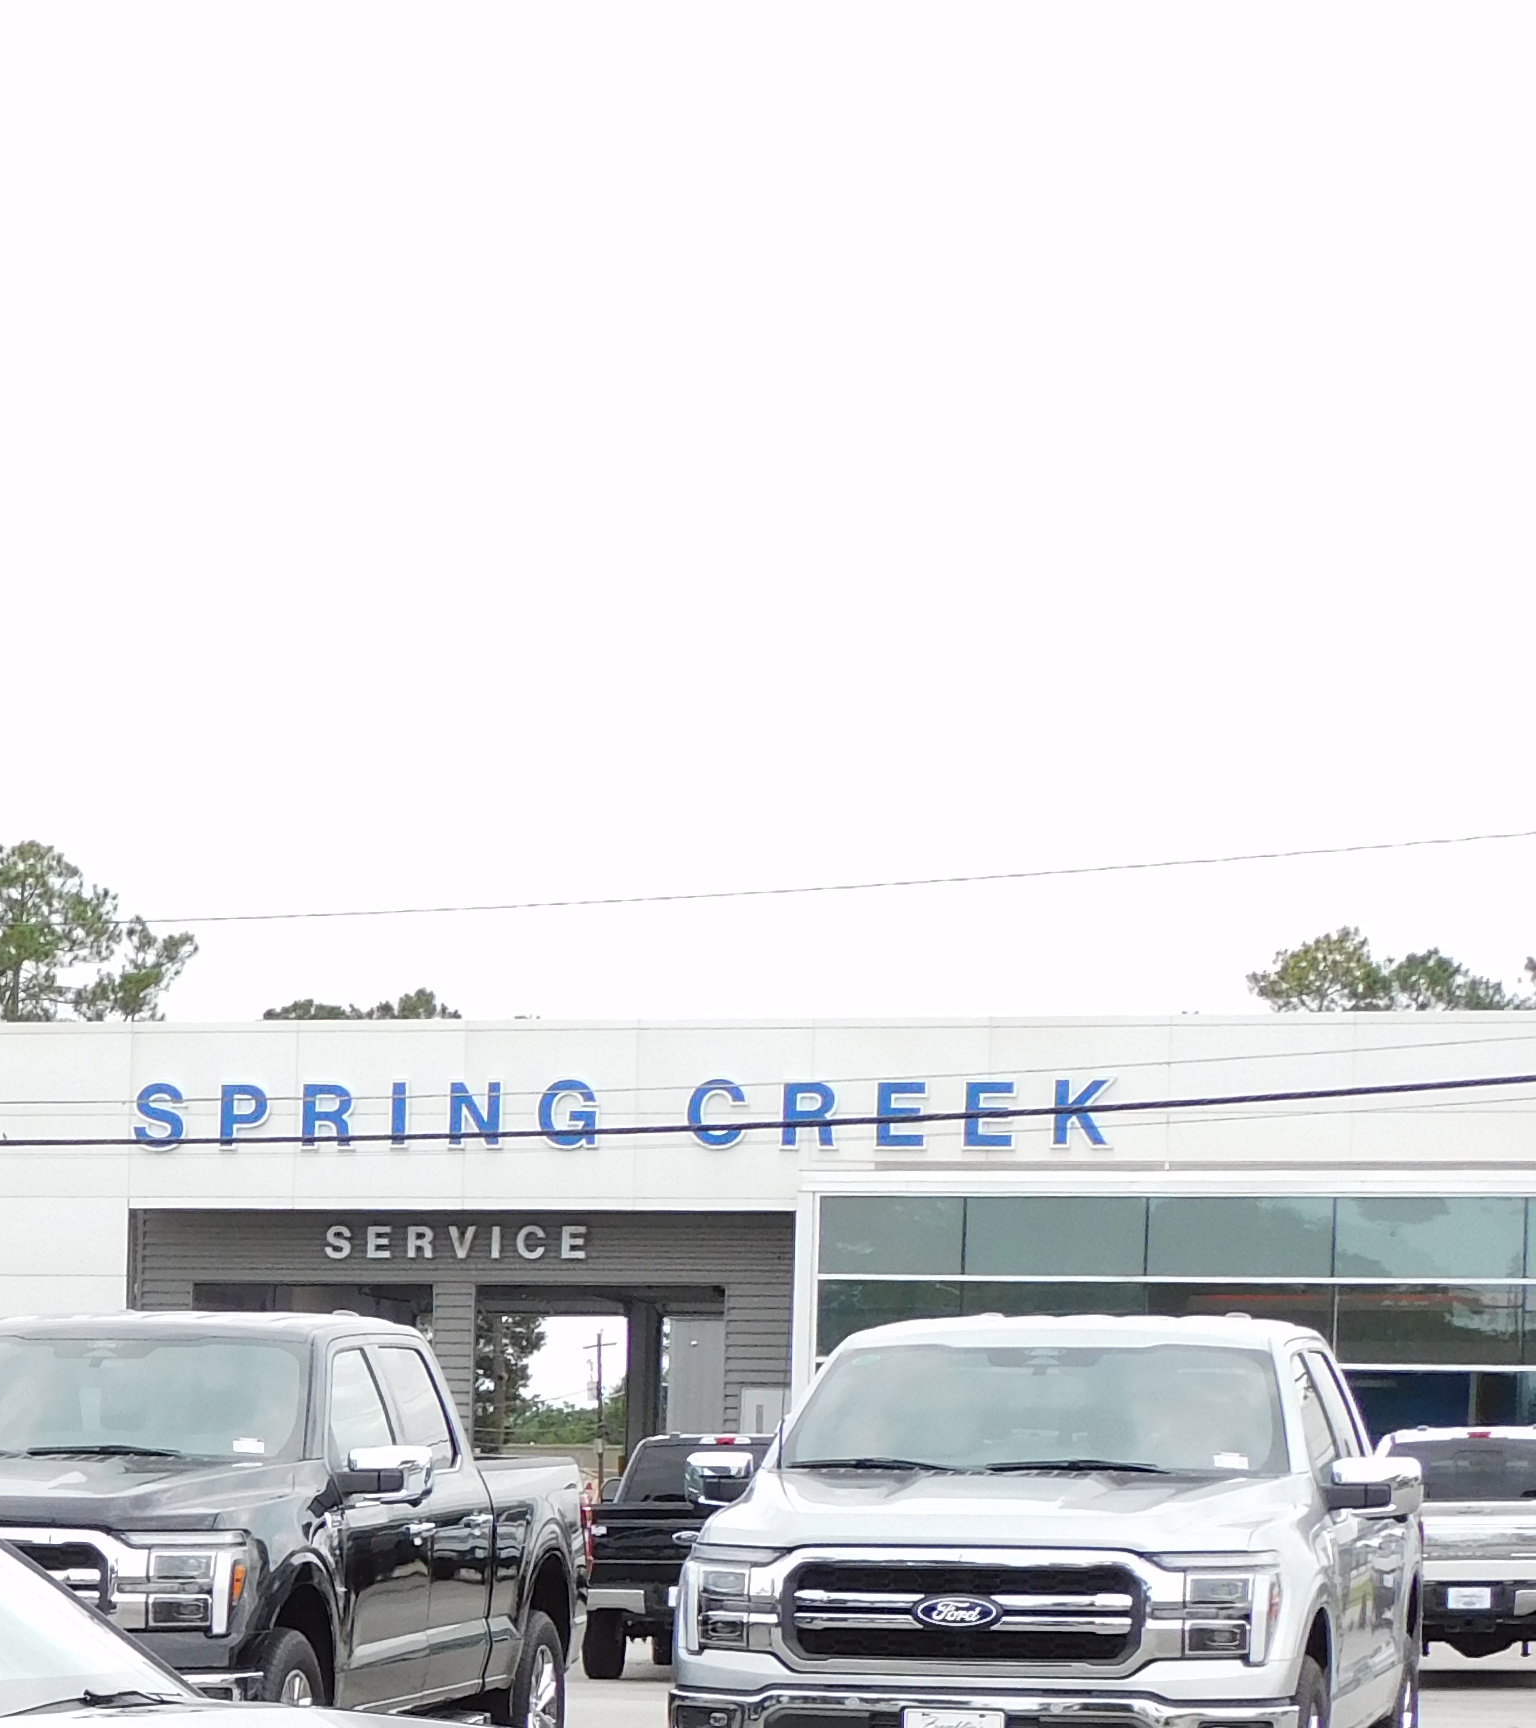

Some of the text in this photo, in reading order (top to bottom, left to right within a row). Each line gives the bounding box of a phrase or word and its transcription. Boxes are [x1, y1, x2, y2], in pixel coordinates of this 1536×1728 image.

[132, 1077, 1117, 1152] SPRING CREEK
[324, 1225, 588, 1260] SERVICE
[932, 1601, 982, 1622] Ford
